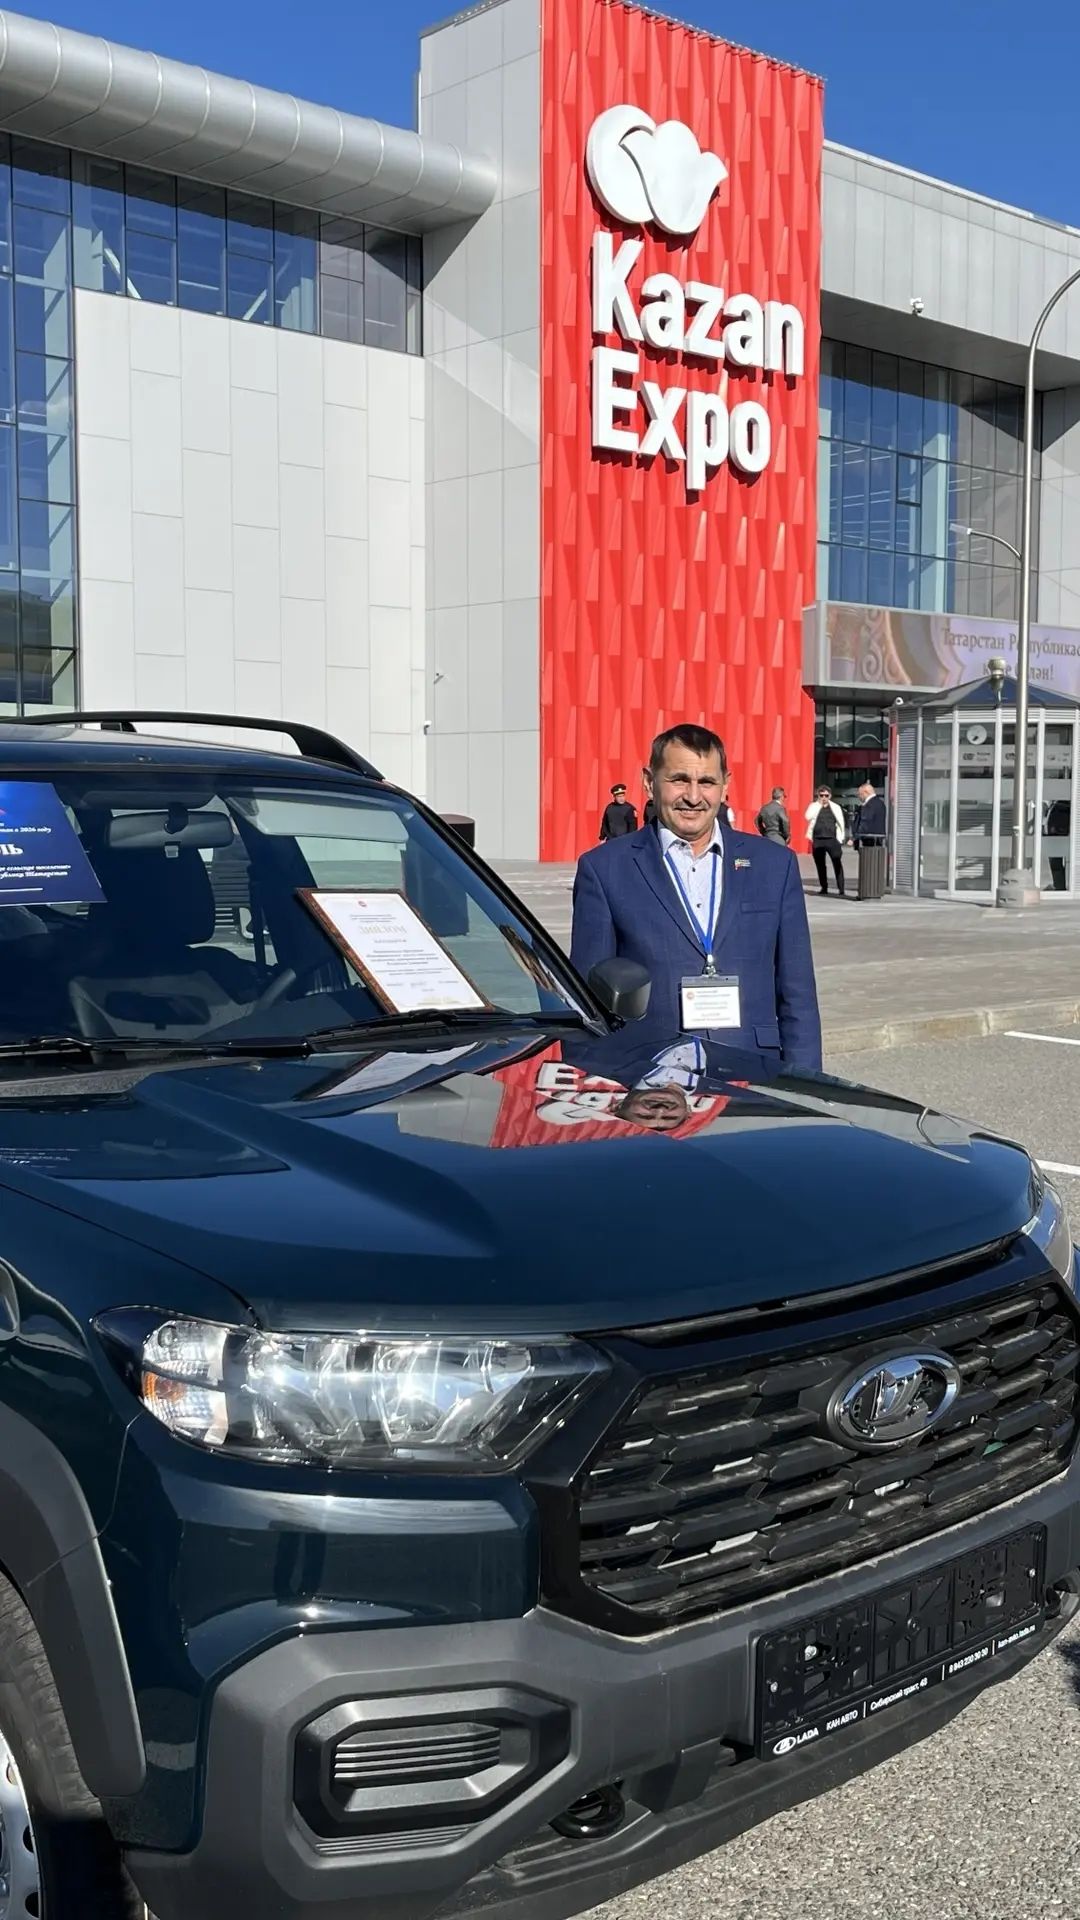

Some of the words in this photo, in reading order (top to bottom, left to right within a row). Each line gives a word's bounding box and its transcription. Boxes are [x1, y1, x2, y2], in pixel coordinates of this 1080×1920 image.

[592, 230, 805, 377] Kazan
[592, 346, 771, 491] Expo
[943, 628, 1005, 652] Татарстан
[1009, 633, 1080, 658] Рпубликас
[797, 1727, 820, 1744] LADA
[826, 1716, 841, 1731] КАН
[840, 1709, 859, 1725] АВТО
